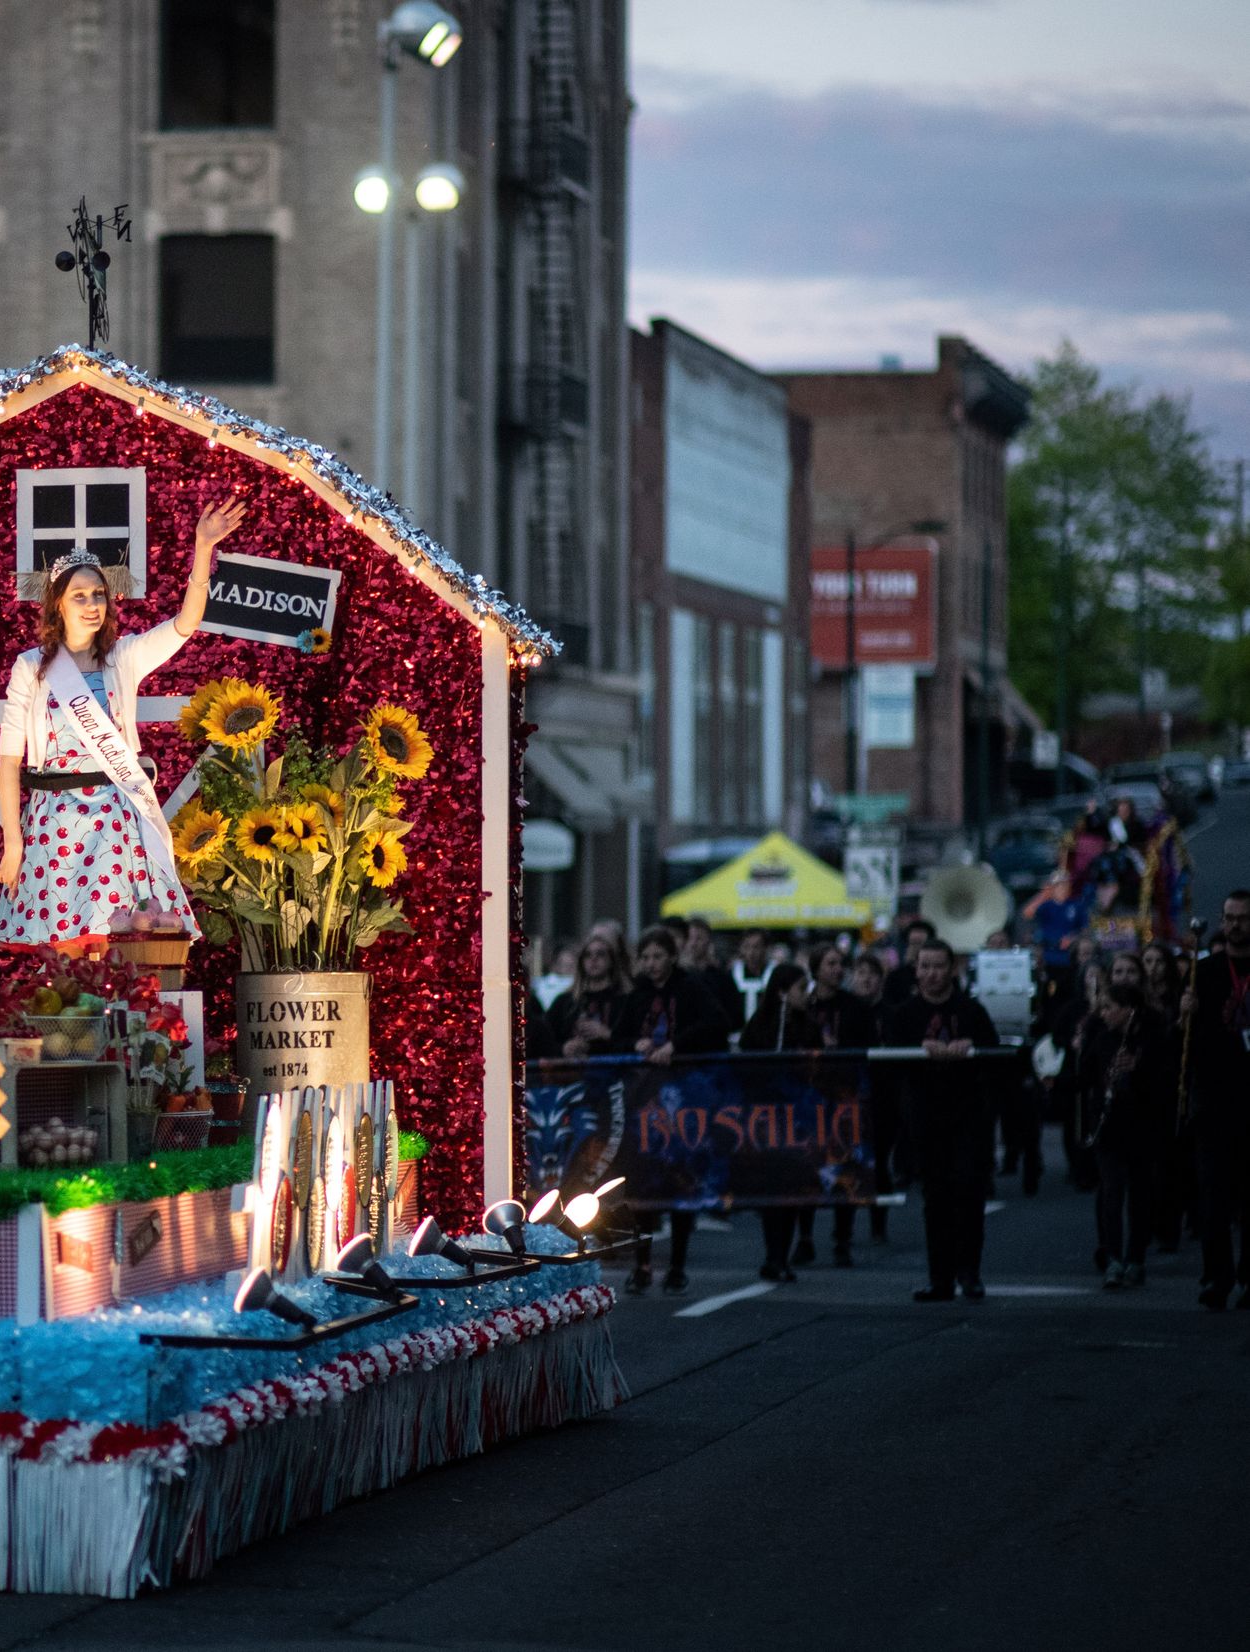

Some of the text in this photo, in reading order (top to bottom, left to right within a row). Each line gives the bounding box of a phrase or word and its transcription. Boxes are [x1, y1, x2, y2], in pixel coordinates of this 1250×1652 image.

[208, 579, 327, 619] MADISON
[69, 694, 132, 782] Queen Madison
[247, 1000, 342, 1023] FLOWER
[249, 1030, 335, 1050] MARKET
[262, 1062, 309, 1078] est 1874
[638, 1102, 861, 1152] ROSALIA
